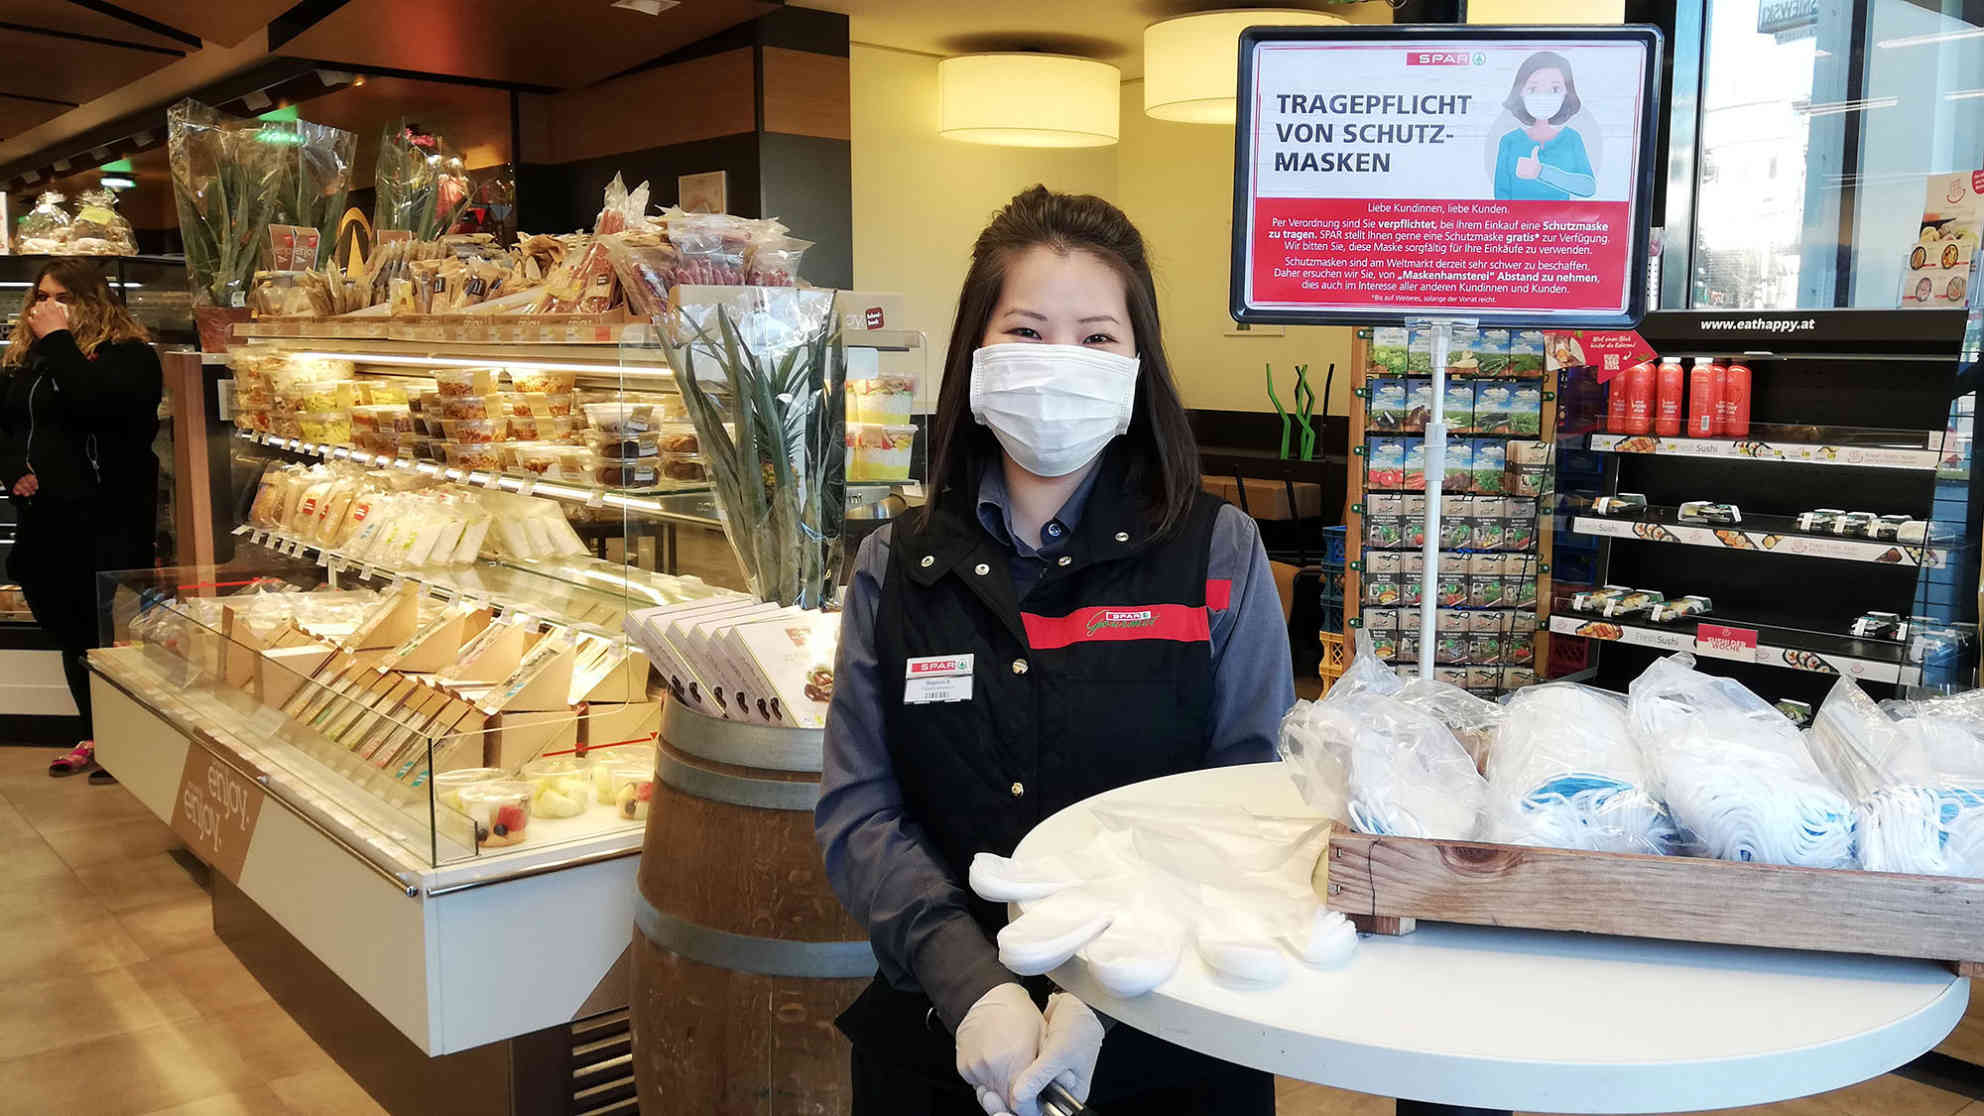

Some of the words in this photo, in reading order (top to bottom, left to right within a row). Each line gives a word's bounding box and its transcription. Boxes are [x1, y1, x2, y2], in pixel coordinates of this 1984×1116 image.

[1418, 53, 1469, 65] SPAR
[1276, 93, 1473, 115] TRAGEPFLICHT
[1275, 122, 1334, 143] VON
[1342, 123, 1455, 145] SCHUTZ-
[1273, 151, 1392, 173] MASKEN
[1368, 203, 1391, 213] Liebe
[1394, 203, 1445, 214] Kundinnen,
[1448, 204, 1470, 214] liebe
[1272, 217, 1286, 227] Per
[1288, 218, 1340, 229] Verordnung
[1342, 219, 1360, 228] sind
[1363, 219, 1376, 229] Sie
[1440, 219, 1454, 230] bei
[1457, 220, 1482, 230] Ihrem
[1485, 220, 1519, 231] Einkauf
[1521, 223, 1541, 231] eine
[1543, 222, 1609, 232] Schutzmaske
[1269, 231, 1281, 240] zu
[1319, 230, 1342, 240] SPAR
[1344, 231, 1365, 240] stellt
[1368, 231, 1393, 241] Ihnen
[1395, 232, 1421, 243] gerne
[1423, 233, 1443, 241] eine
[1445, 231, 1504, 242] Schutzmaske
[1542, 234, 1557, 243] zur
[1284, 241, 1300, 251] Wir
[1302, 242, 1328, 251] bitten
[1348, 242, 1372, 252] diese
[1374, 243, 1402, 252] Maske
[1405, 242, 1447, 255] sorgfältig
[1450, 243, 1462, 254] für
[1465, 244, 1482, 254] Ihre
[1484, 243, 1523, 255] Einkäufe
[1525, 246, 1537, 255] zu
[1539, 245, 1593, 255] verwenden.
[1284, 257, 1347, 267] Schutzmasken
[1350, 258, 1368, 267] sind
[1370, 259, 1384, 267] am
[1386, 258, 1433, 268] Weltmarkt
[1435, 259, 1466, 269] derzeit
[1468, 259, 1487, 270] sehr
[1489, 260, 1522, 270] schwer
[1524, 263, 1536, 271] zu
[1538, 260, 1590, 271] beschaffen.
[1273, 268, 1301, 278] Daher
[1302, 268, 1342, 279] ersuchen
[1344, 269, 1359, 279] wir
[1379, 271, 1395, 279] von
[1497, 272, 1539, 282] Abstand
[1541, 274, 1554, 283] zu
[1302, 280, 1319, 290] dies
[1321, 280, 1342, 290] auch
[1345, 281, 1357, 290] im
[1358, 281, 1397, 291] Interesse
[1399, 281, 1418, 291] aller
[1420, 281, 1457, 292] anderen
[1459, 282, 1509, 293] Kundinnen
[1511, 283, 1529, 294] und
[1700, 317, 1816, 333] www.eathappy.at
[919, 660, 956, 673] SPAR
